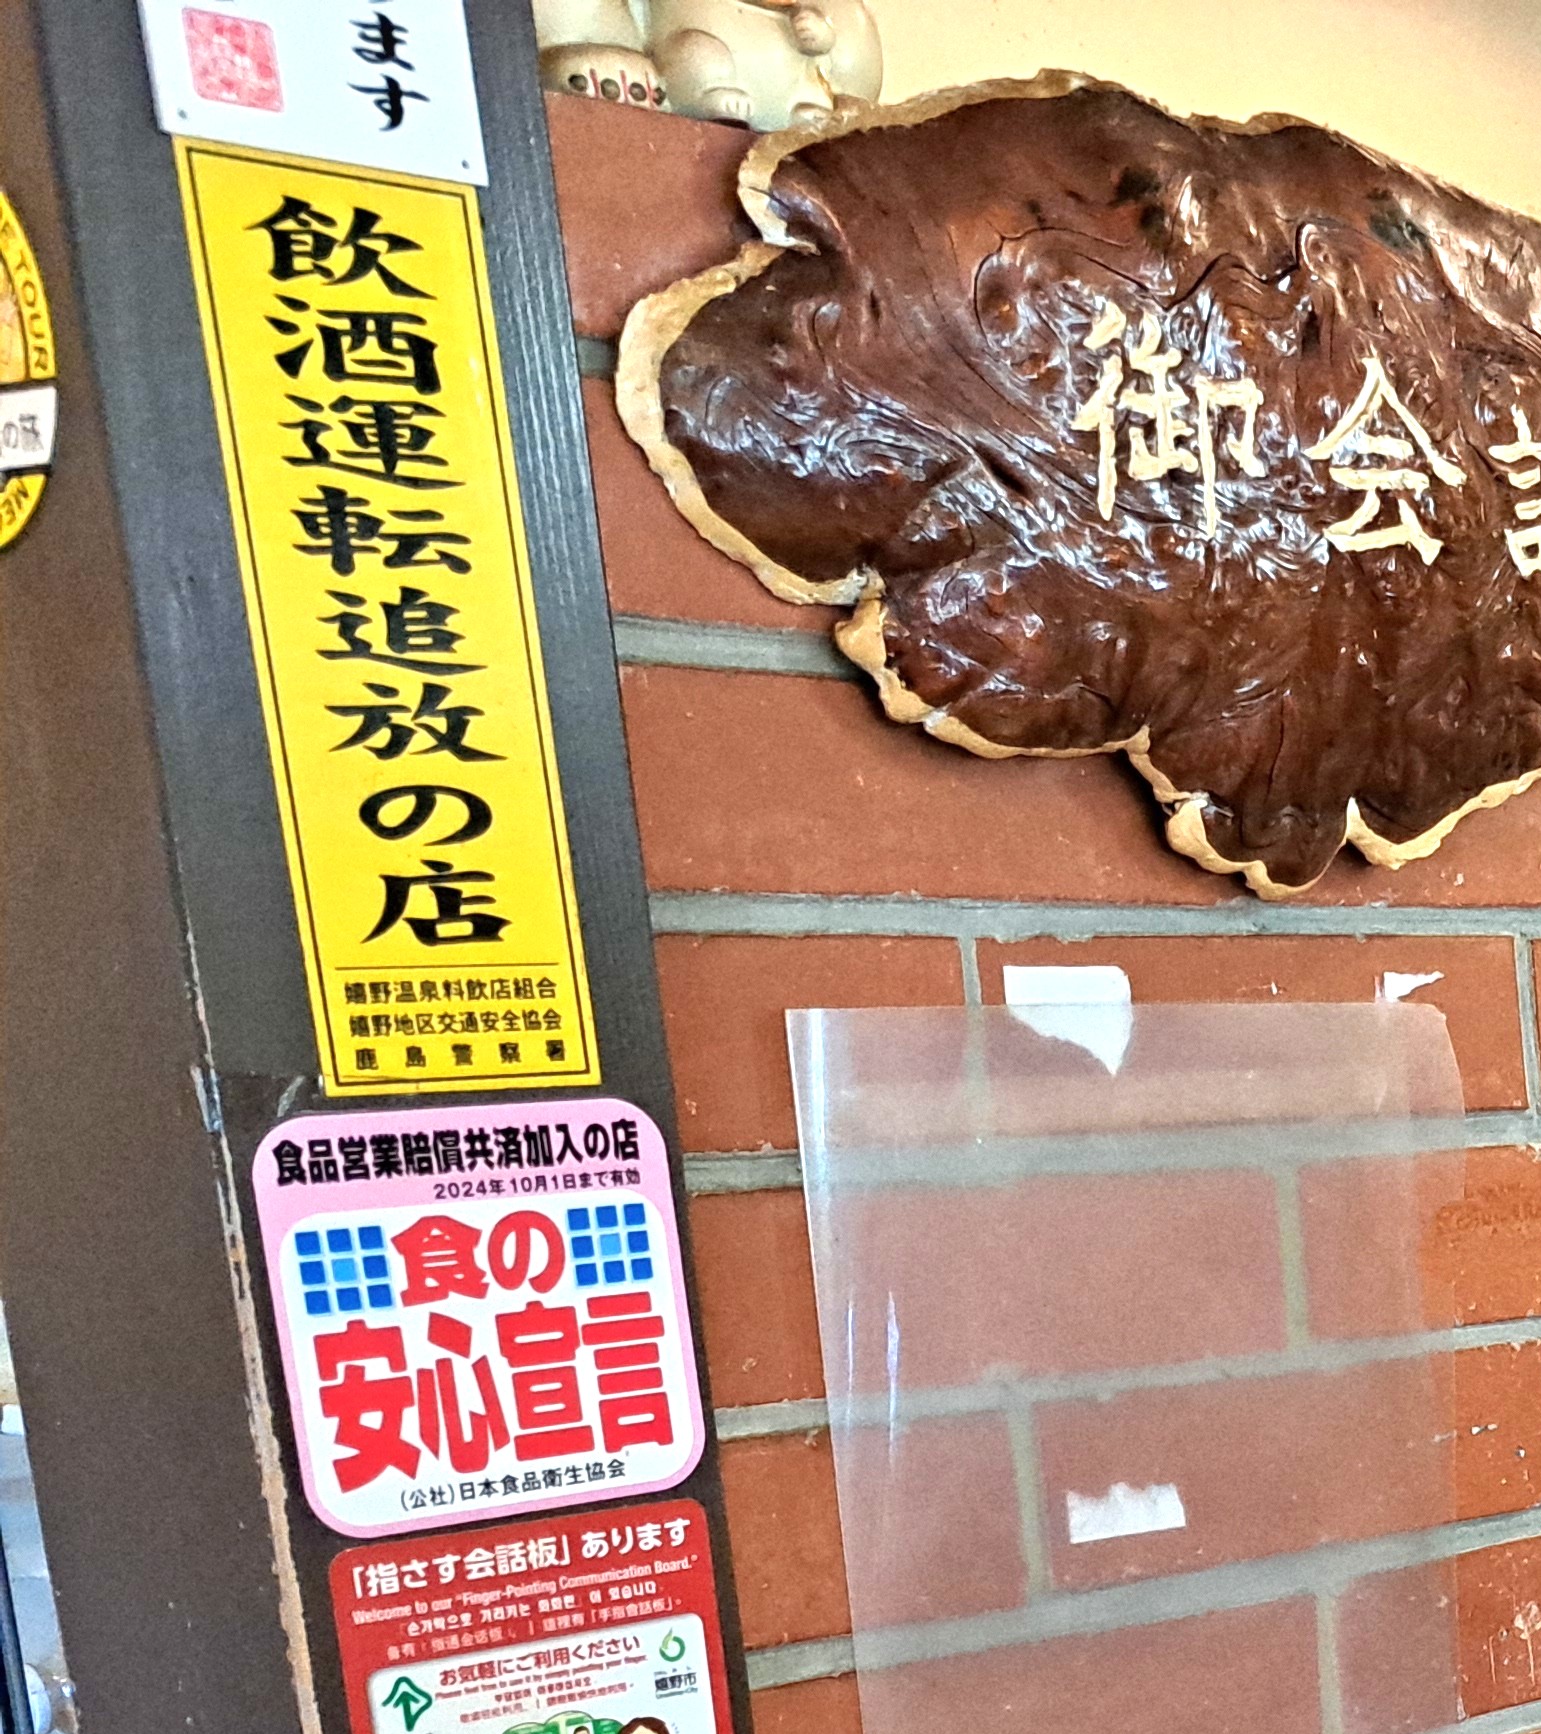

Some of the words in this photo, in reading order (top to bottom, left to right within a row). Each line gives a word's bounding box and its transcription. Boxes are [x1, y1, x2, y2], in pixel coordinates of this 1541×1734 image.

[243, 195, 514, 947] 飲酒運転追放の店
[344, 977, 557, 1006] 嬉野温泉料飲店組合
[349, 1009, 563, 1038] 嬉野地区交通安全協会
[272, 1118, 641, 1187] 食品営業賠償共済加入の店
[433, 1167, 641, 1200] 2024年10月1日まで有効
[390, 1209, 566, 1307] 食の
[312, 1290, 675, 1493] 安心宣言
[400, 1458, 628, 1512] (公社)日本食品衛生協会
[350, 1605, 412, 1626] Welcome
[438, 1634, 641, 1687] お気軽にご利用ください
